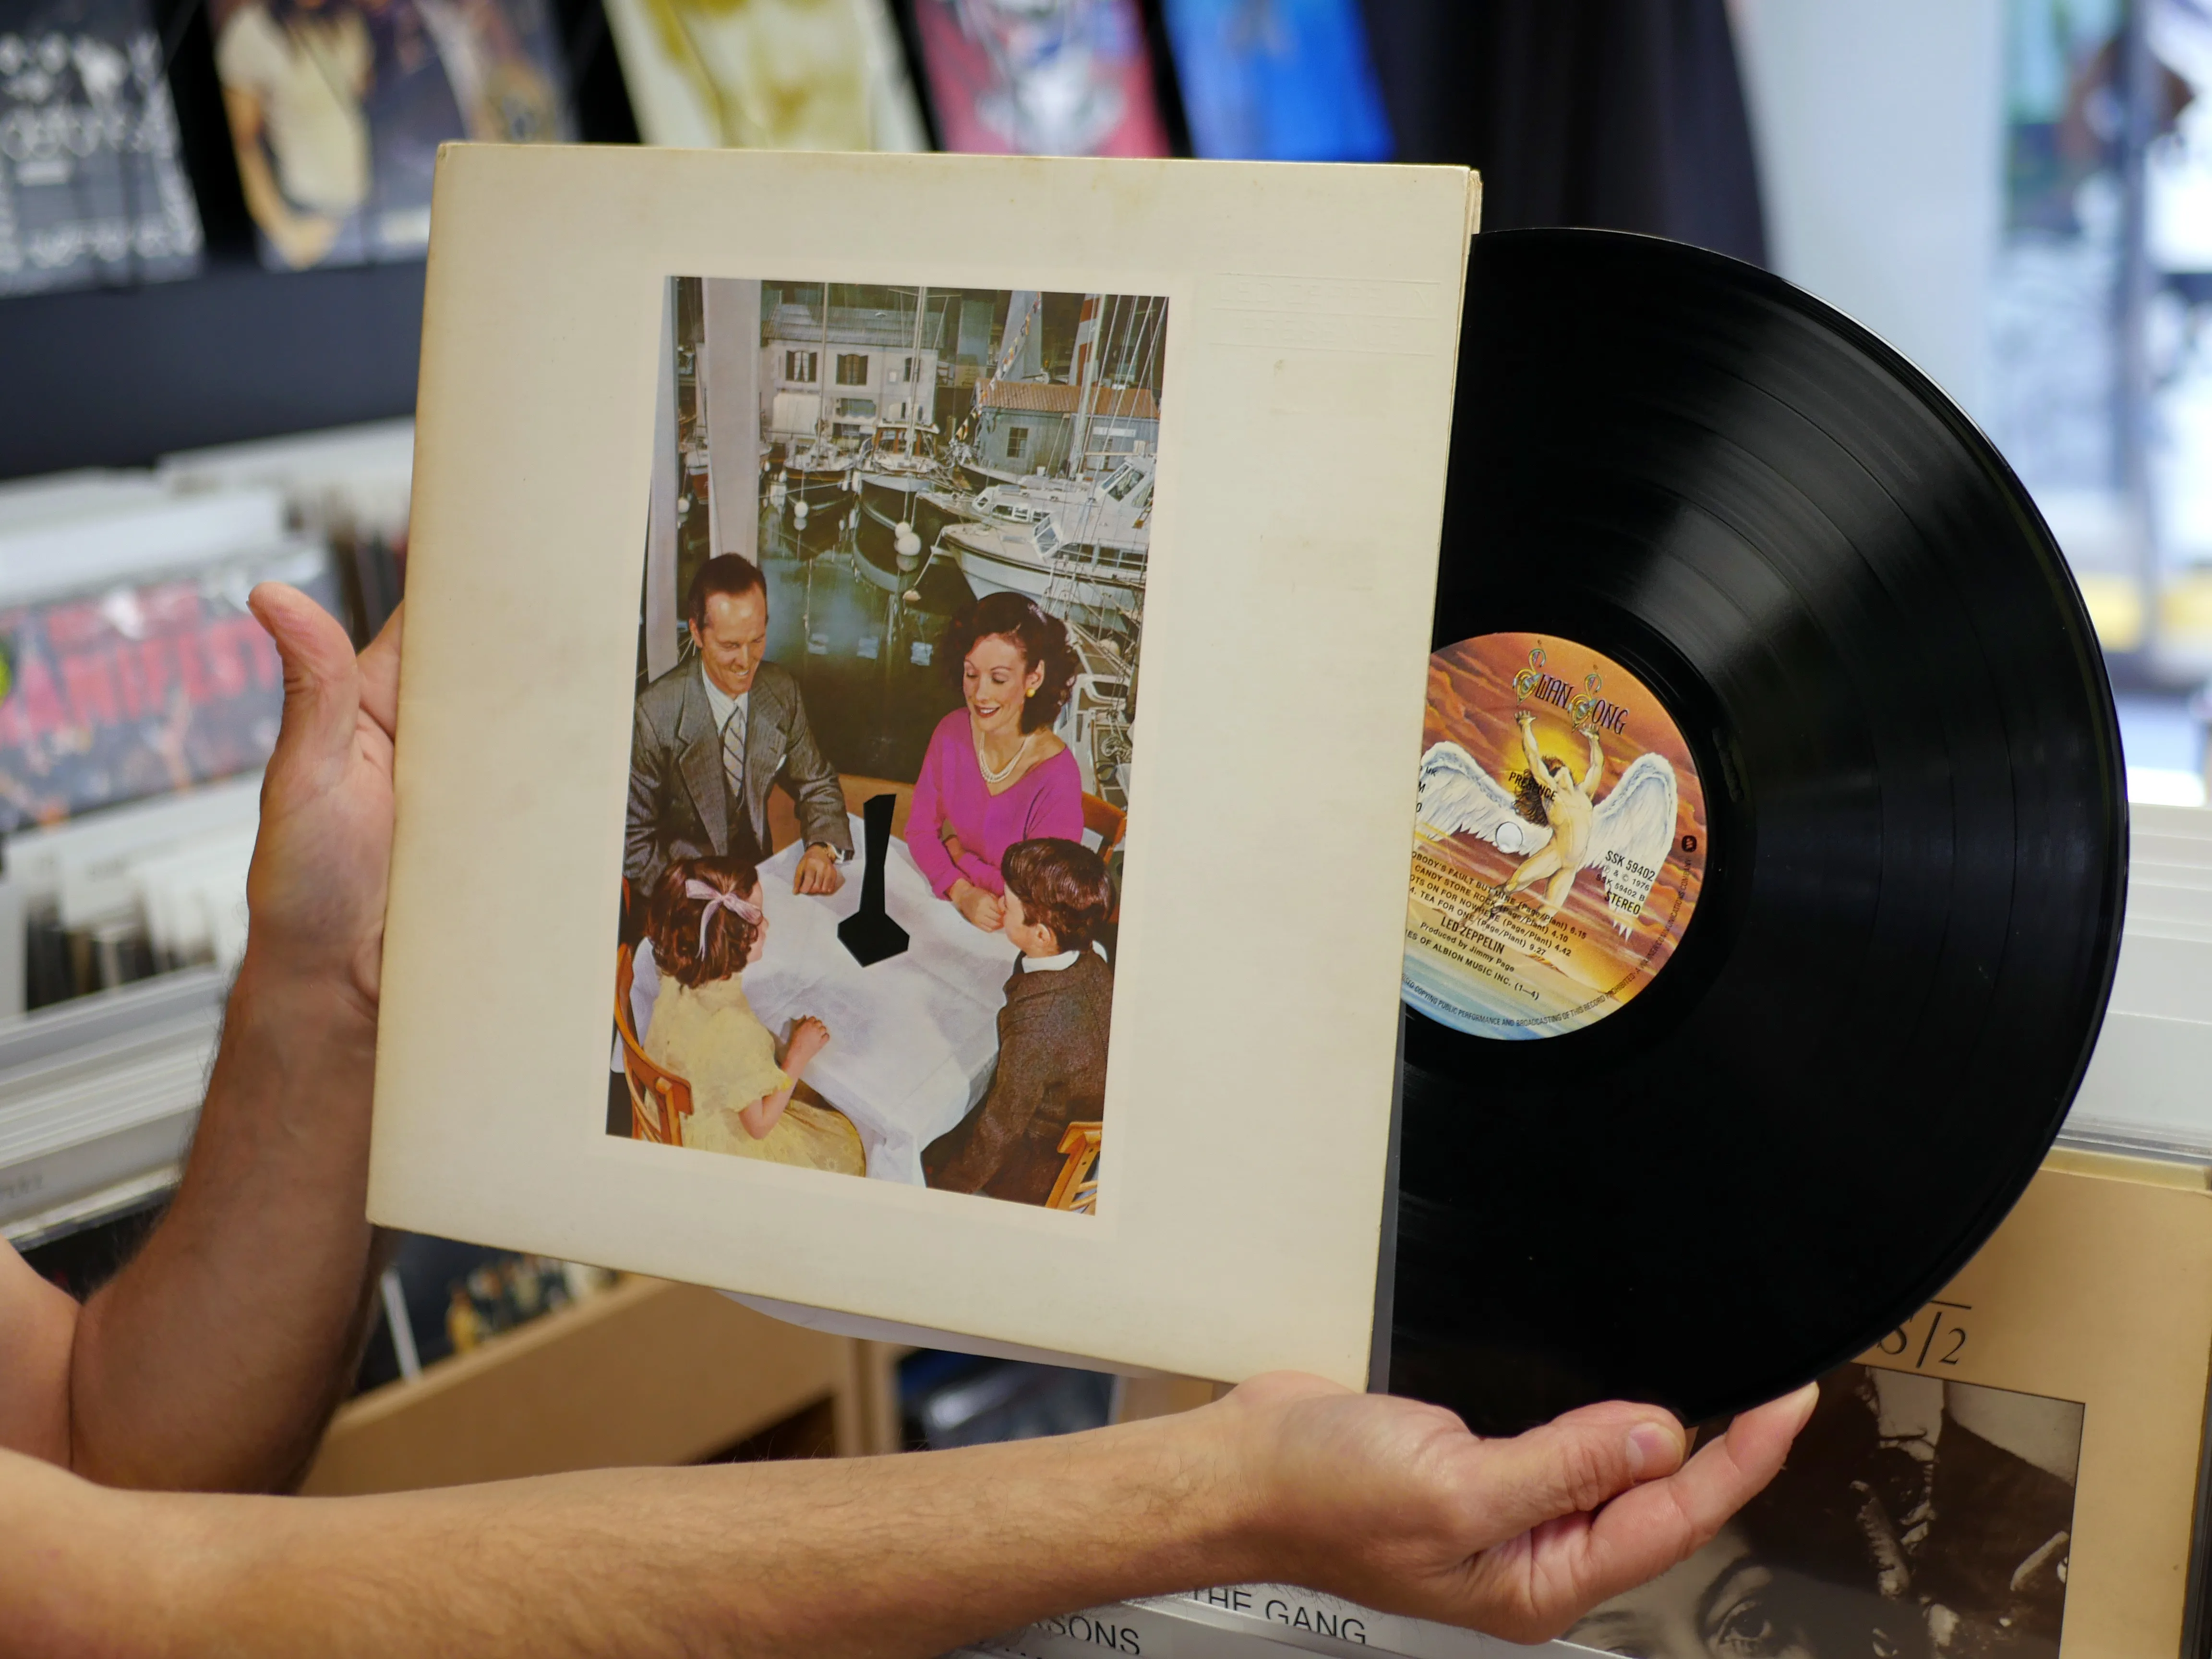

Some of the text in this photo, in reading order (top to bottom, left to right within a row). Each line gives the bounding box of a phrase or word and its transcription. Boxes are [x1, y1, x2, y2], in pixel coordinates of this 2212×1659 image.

[1513, 648, 1629, 735] SWAN SONG
[1508, 771, 1557, 801] PRESENCE
[1412, 851, 1446, 872] OBODY'S
[1448, 868, 1474, 884] FAULT
[1476, 881, 1493, 893] BUT
[1493, 890, 1516, 905] MINE
[1517, 902, 1568, 931] (Page/Plant)
[1596, 873, 1613, 887] SSK
[1614, 883, 1637, 899] 59402
[1605, 850, 1656, 882] SSK 59402
[1632, 878, 1650, 891] 1976
[1410, 875, 1572, 956] OTS ON FOR NOWHERE (Page/Plant) 4.42
[1415, 865, 1568, 942] CANDY STORE ROCK (Page/Plant) 4.10
[1420, 890, 1435, 903] TEA
[1437, 899, 1455, 912] FOR
[1456, 909, 1475, 921] ONE
[1477, 918, 1527, 948] (Page/Plant)
[1529, 943, 1546, 956] 9.27
[1604, 890, 1641, 915] STEREO
[1420, 922, 1515, 973] Produced by Jimmy Page
[1440, 916, 1505, 954] LED ZEPPELIN
[1419, 936, 1432, 946] OF
[1432, 943, 1464, 962] ALBION
[1465, 958, 1493, 976] MUSIC
[1494, 972, 1511, 986] INC.
[1415, 985, 1438, 1005] COPYING
[1437, 999, 1458, 1015] PUBLIC
[1458, 1009, 1501, 1026] PERFORMANCE
[1501, 1018, 1515, 1027] AND
[1516, 1013, 1562, 1027] BROADCASTING
[1562, 1010, 1571, 1020] OF
[1570, 1006, 1584, 1017] THIS
[1583, 995, 1606, 1011] RECORD
[1194, 1587, 1366, 1645] HE GANG
